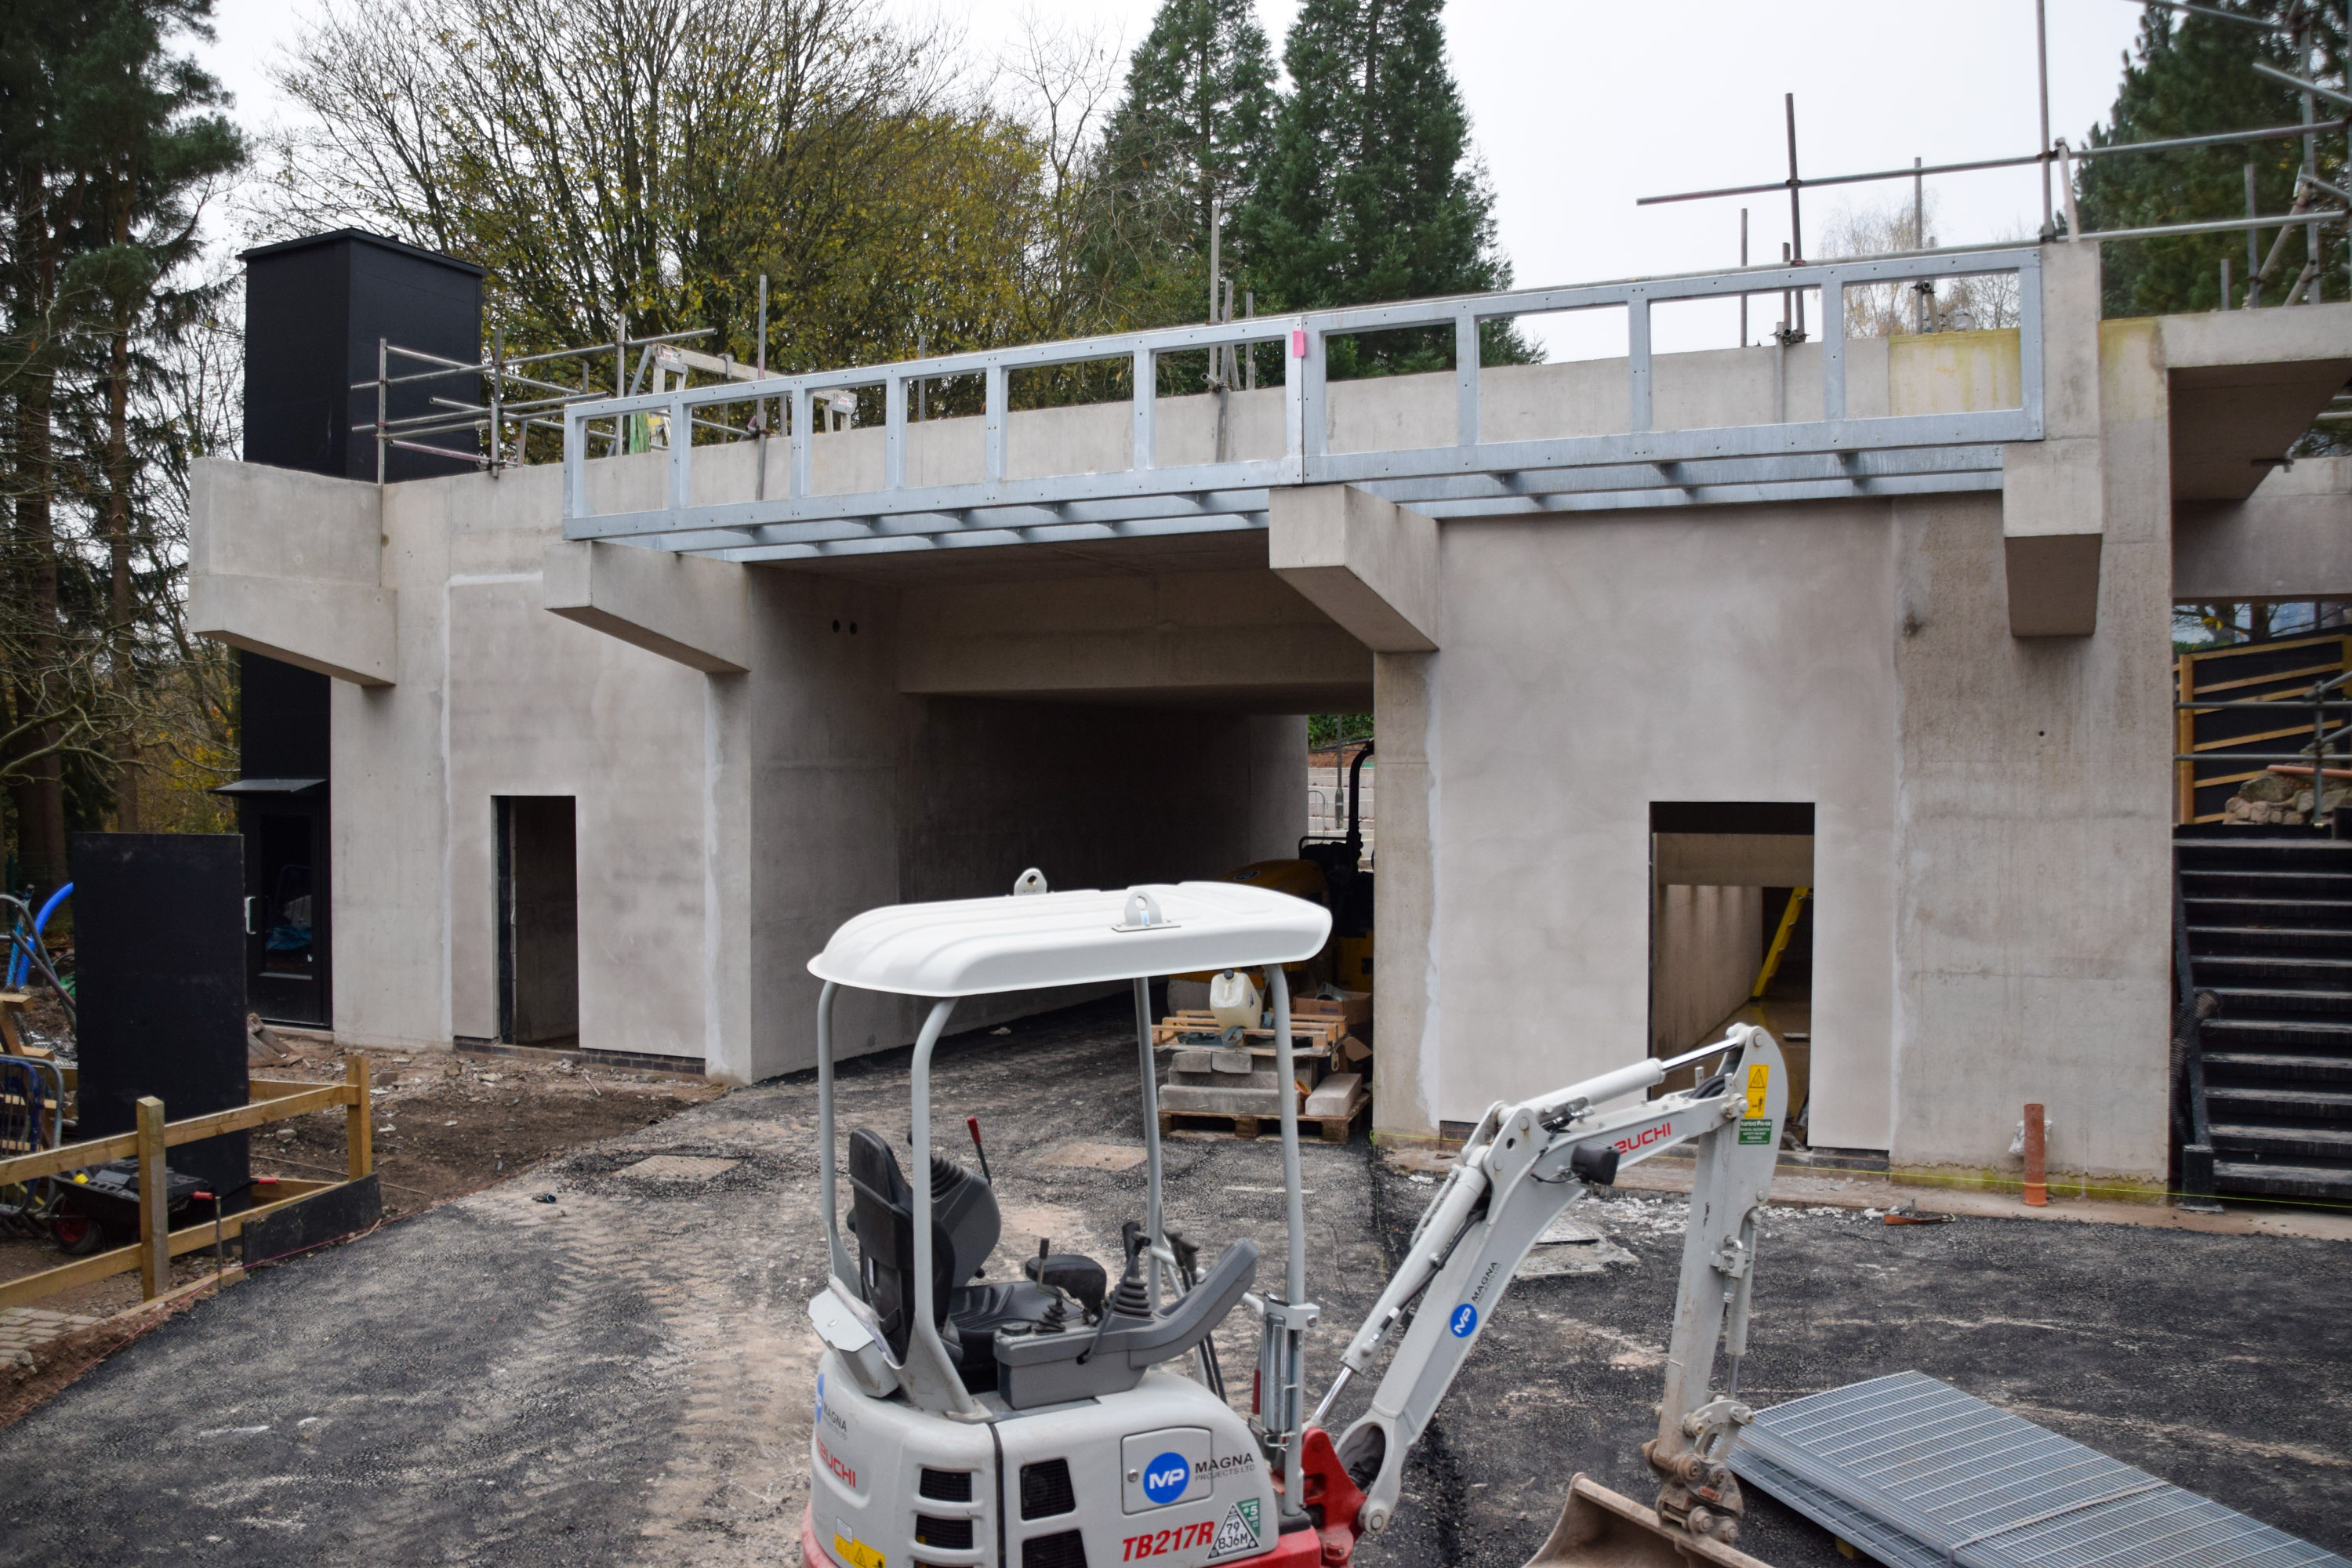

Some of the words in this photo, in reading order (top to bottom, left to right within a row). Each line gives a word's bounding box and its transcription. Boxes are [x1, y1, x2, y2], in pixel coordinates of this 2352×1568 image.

[1613, 1122, 1671, 1155] EUCHI
[1471, 1262, 1497, 1302] MAGNA
[823, 1402, 847, 1433] MAGNA
[1195, 1453, 1254, 1474] MAGNA
[1195, 1468, 1240, 1482] PROJECTS
[1240, 1465, 1255, 1473] LTD
[1250, 1505, 1258, 1516] 5
[1226, 1521, 1240, 1535] 79
[1123, 1521, 1215, 1562] TB217R
[1218, 1532, 1248, 1549] BJ6M
